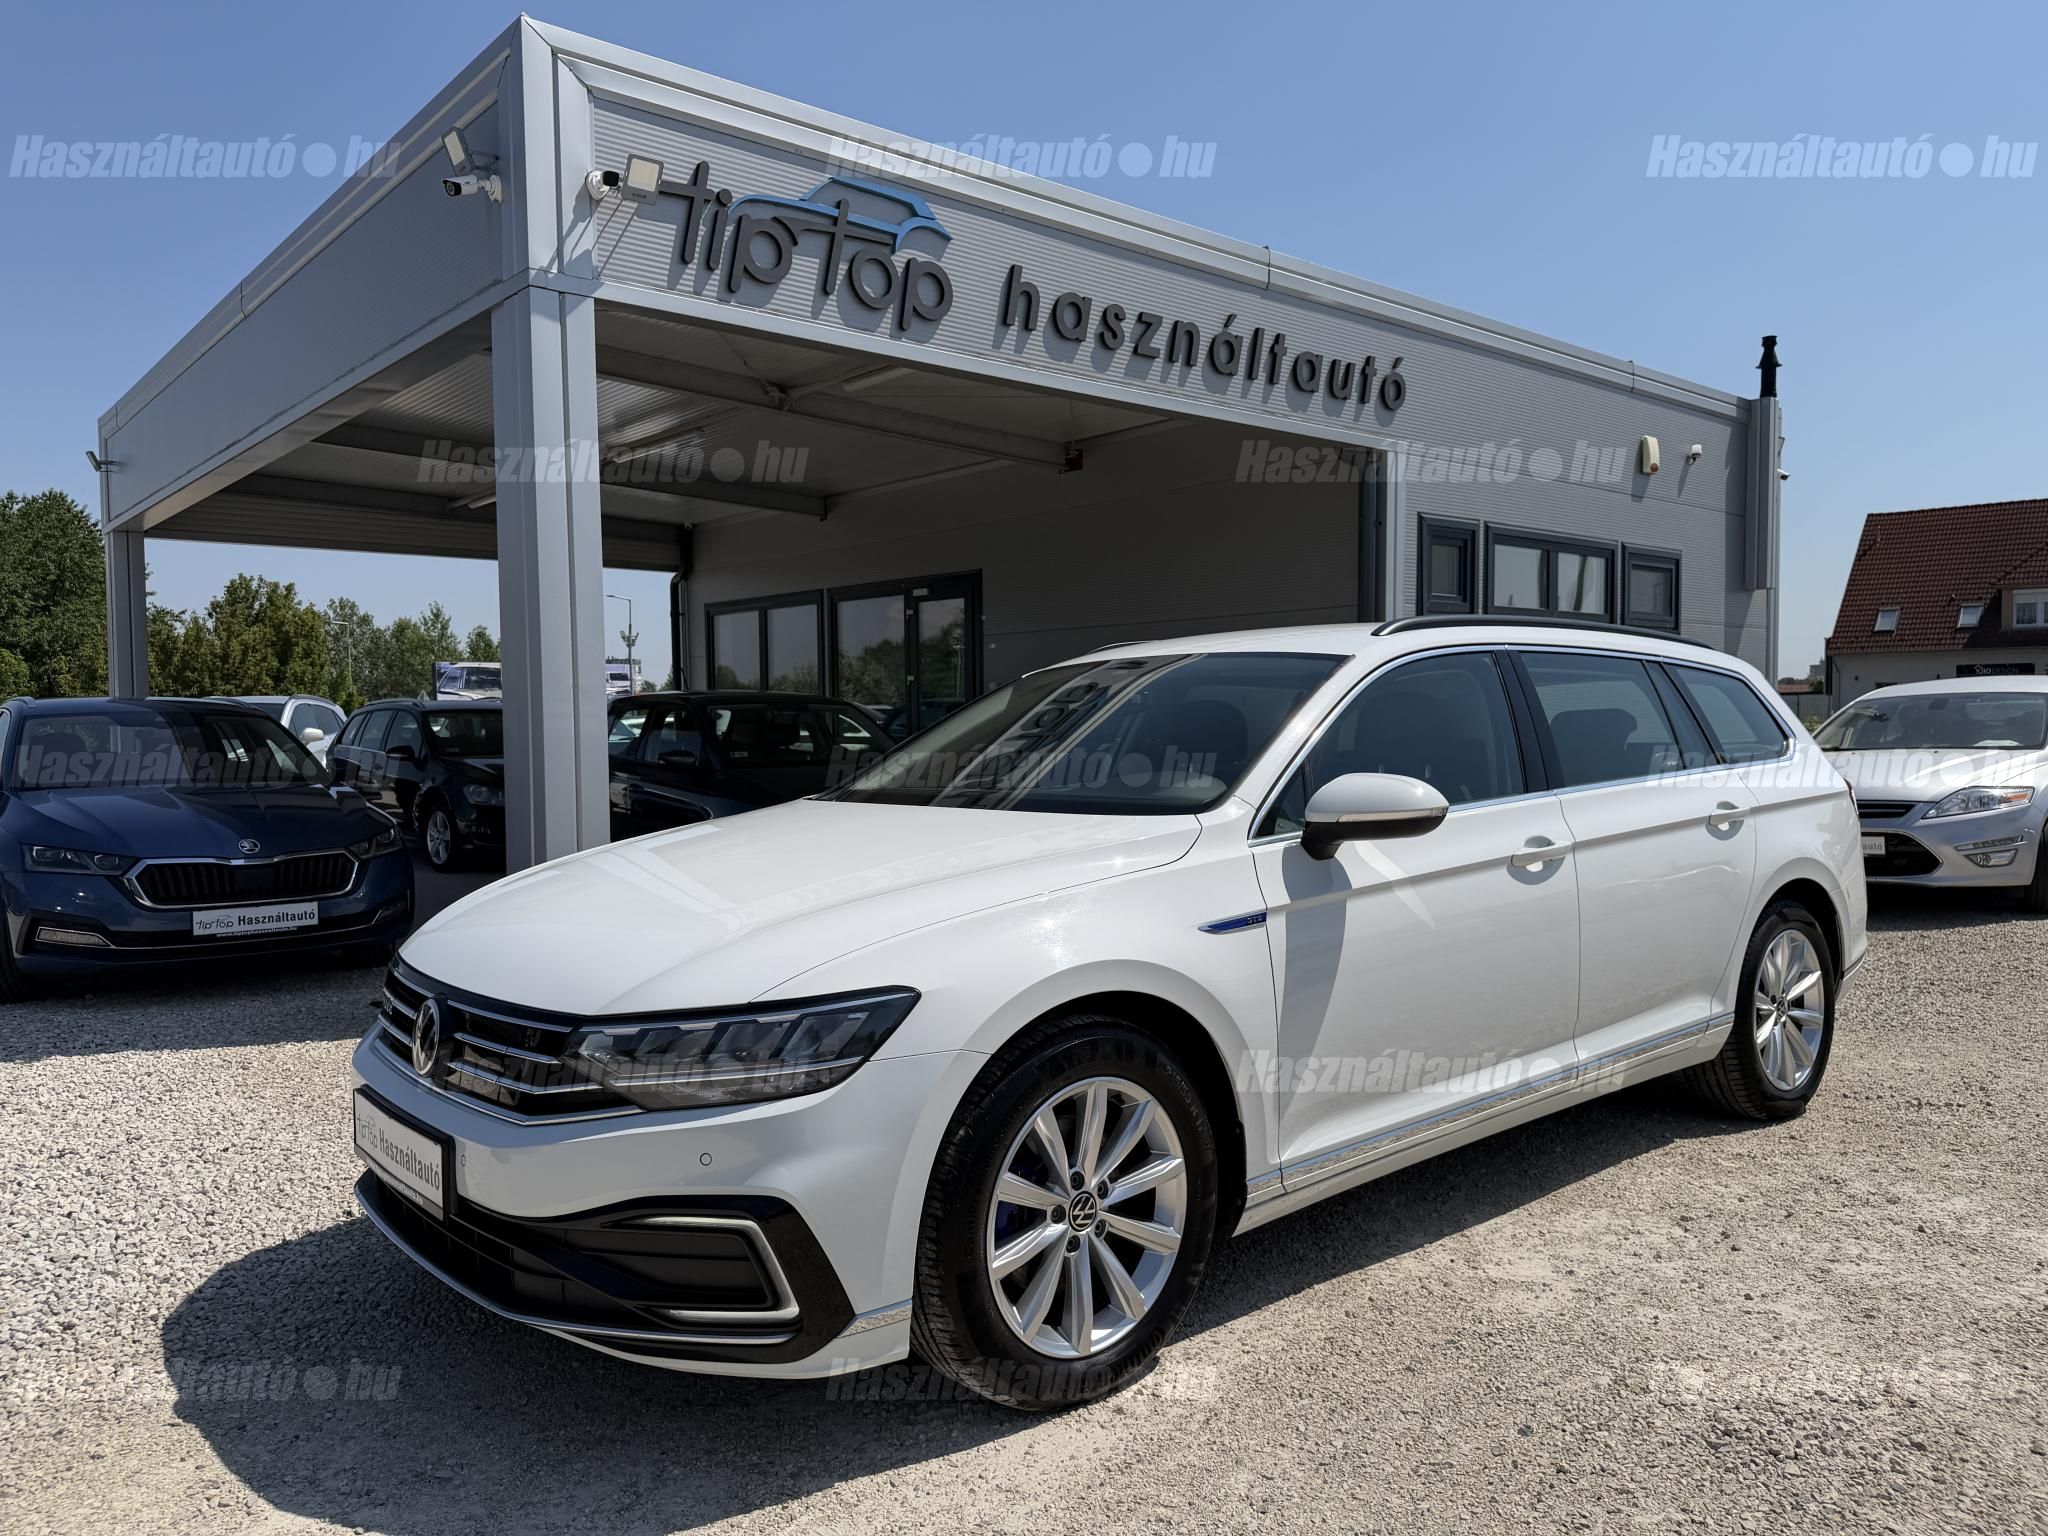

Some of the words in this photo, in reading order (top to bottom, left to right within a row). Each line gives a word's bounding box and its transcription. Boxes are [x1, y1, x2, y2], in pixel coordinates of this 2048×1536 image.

[1002, 264, 1407, 411] használtautó
[238, 909, 315, 926] Használtautó
[379, 1127, 440, 1191] Használtautó
